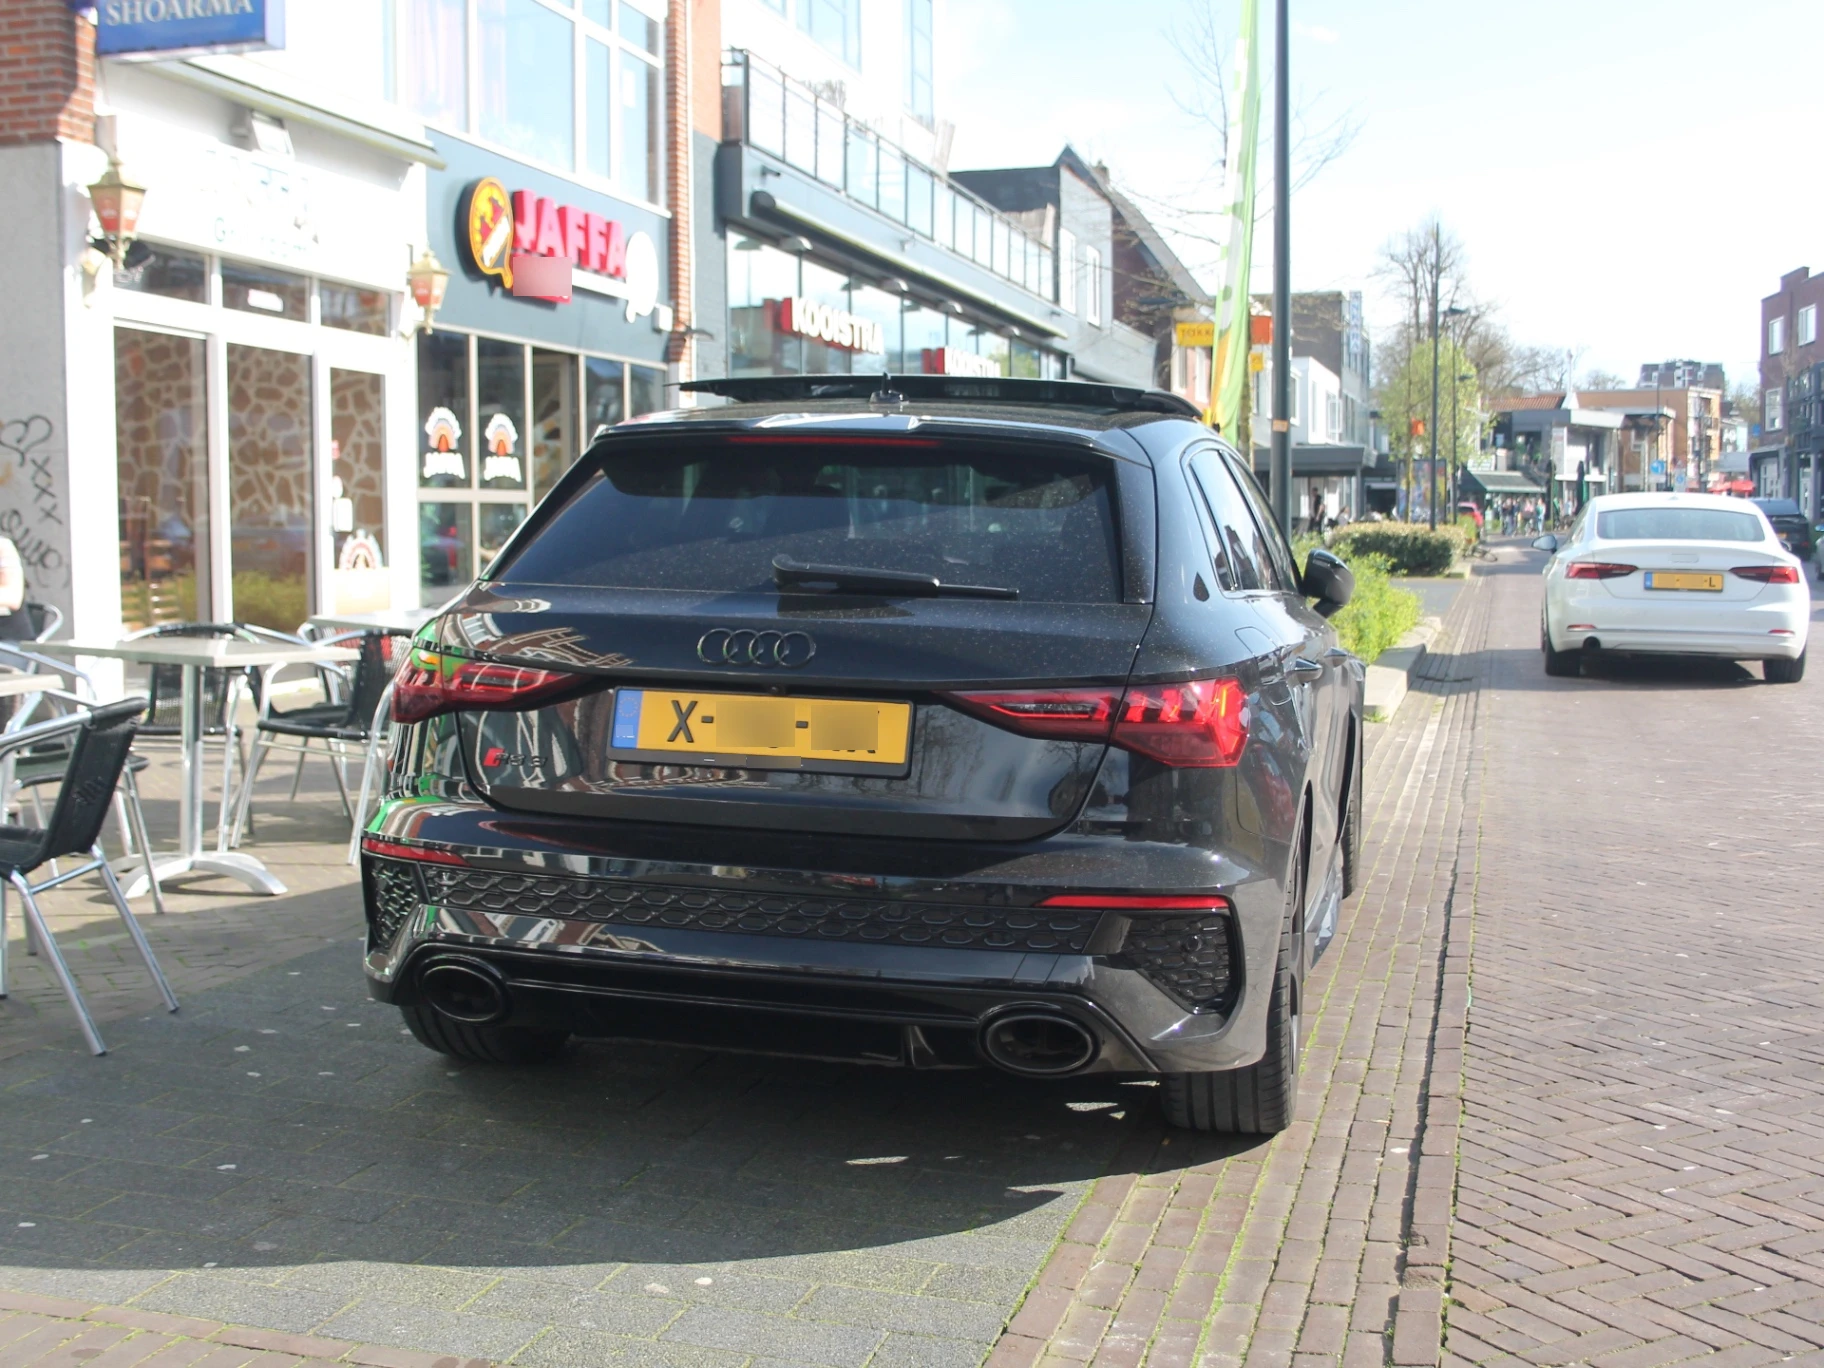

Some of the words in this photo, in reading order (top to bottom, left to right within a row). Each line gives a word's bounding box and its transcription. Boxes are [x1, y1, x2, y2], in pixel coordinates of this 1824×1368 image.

[105, 0, 254, 26] SHOARMA
[514, 190, 627, 278] JAFFA
[792, 297, 883, 354] KOOISTRA
